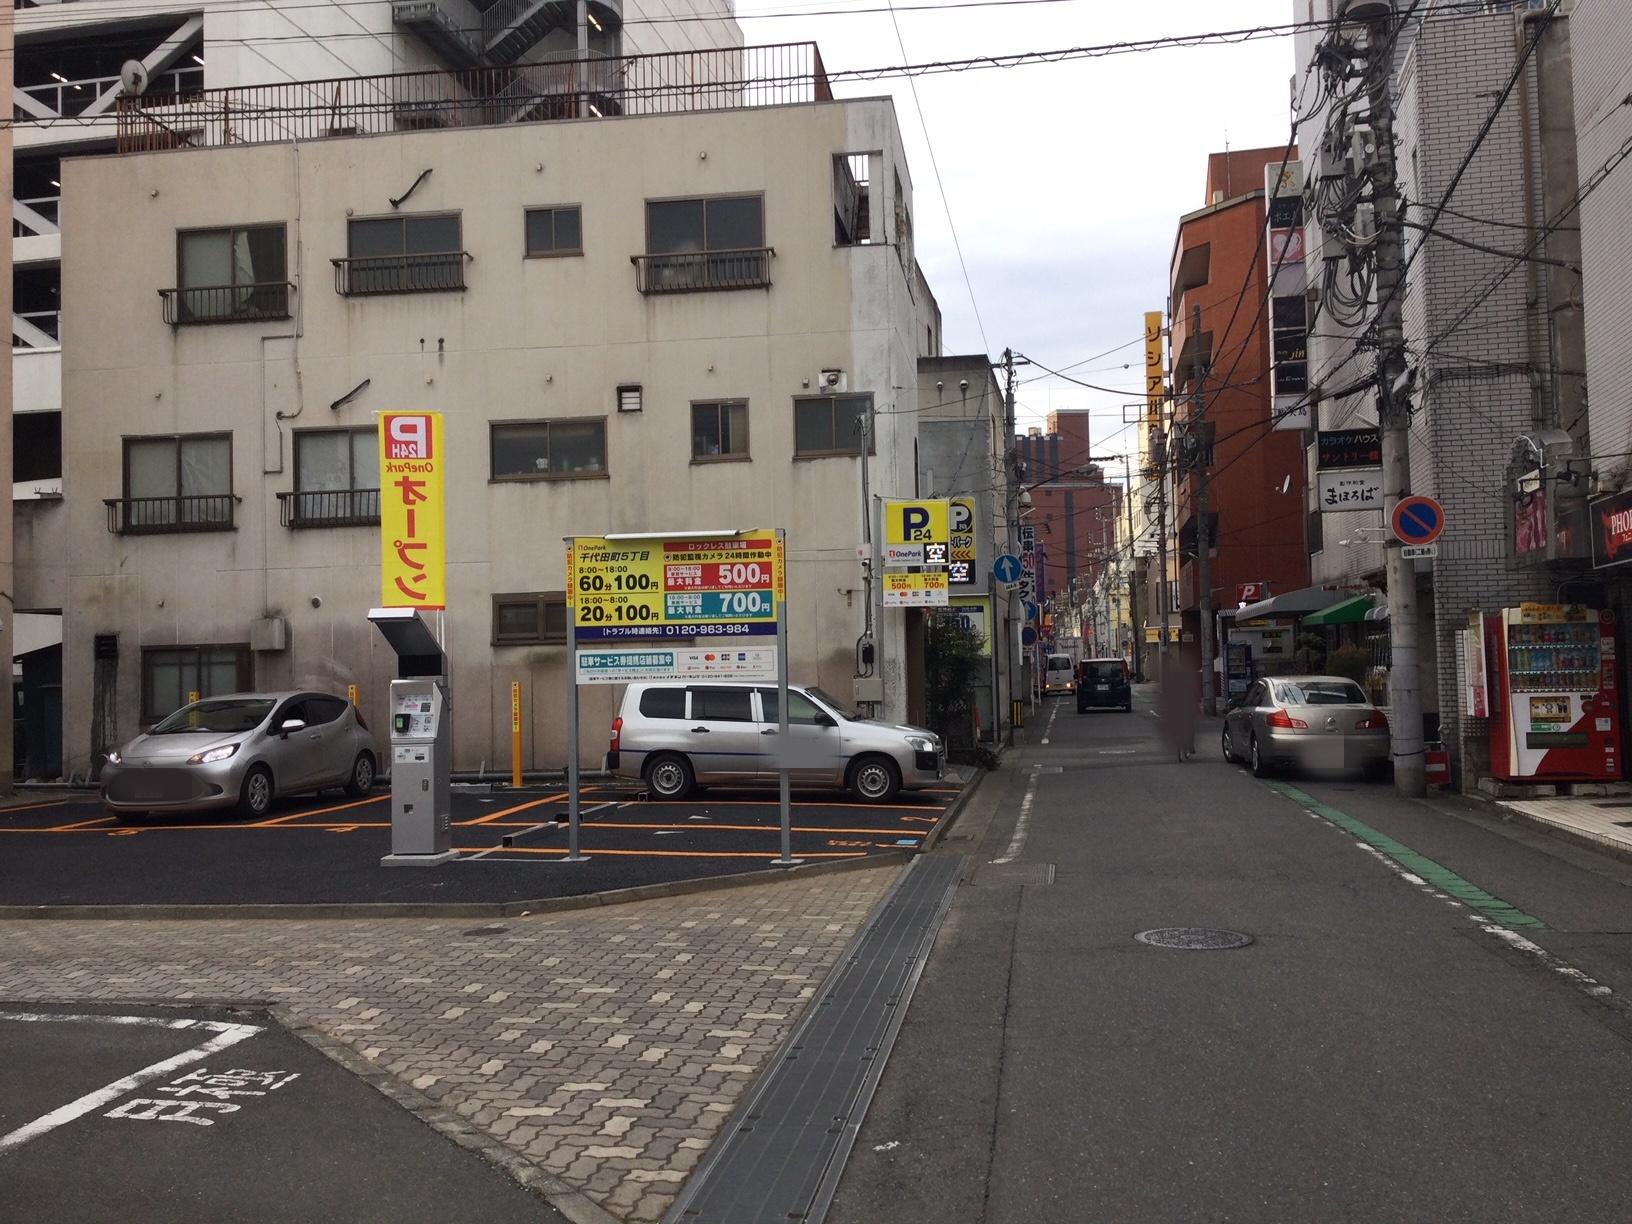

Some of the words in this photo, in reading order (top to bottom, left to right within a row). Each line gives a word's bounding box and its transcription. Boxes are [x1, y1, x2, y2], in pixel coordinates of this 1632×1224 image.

[1321, 434, 1379, 446] カラオケハウス
[1325, 486, 1380, 505] まほろば
[903, 507, 930, 541] P
[950, 506, 970, 530] P
[914, 529, 933, 541] 24
[580, 551, 650, 563] 千代田町5丁目
[896, 550, 922, 558] OnePark
[927, 543, 946, 563] 空
[719, 563, 770, 584] 500円
[949, 561, 969, 582] 空
[668, 577, 702, 586] 最大料金
[892, 582, 912, 590] 500円
[924, 581, 945, 589] 700円
[1242, 585, 1255, 600] P
[720, 592, 770, 613] 700円
[668, 606, 702, 614] 最大料金
[666, 624, 750, 635] 0120-963-984
